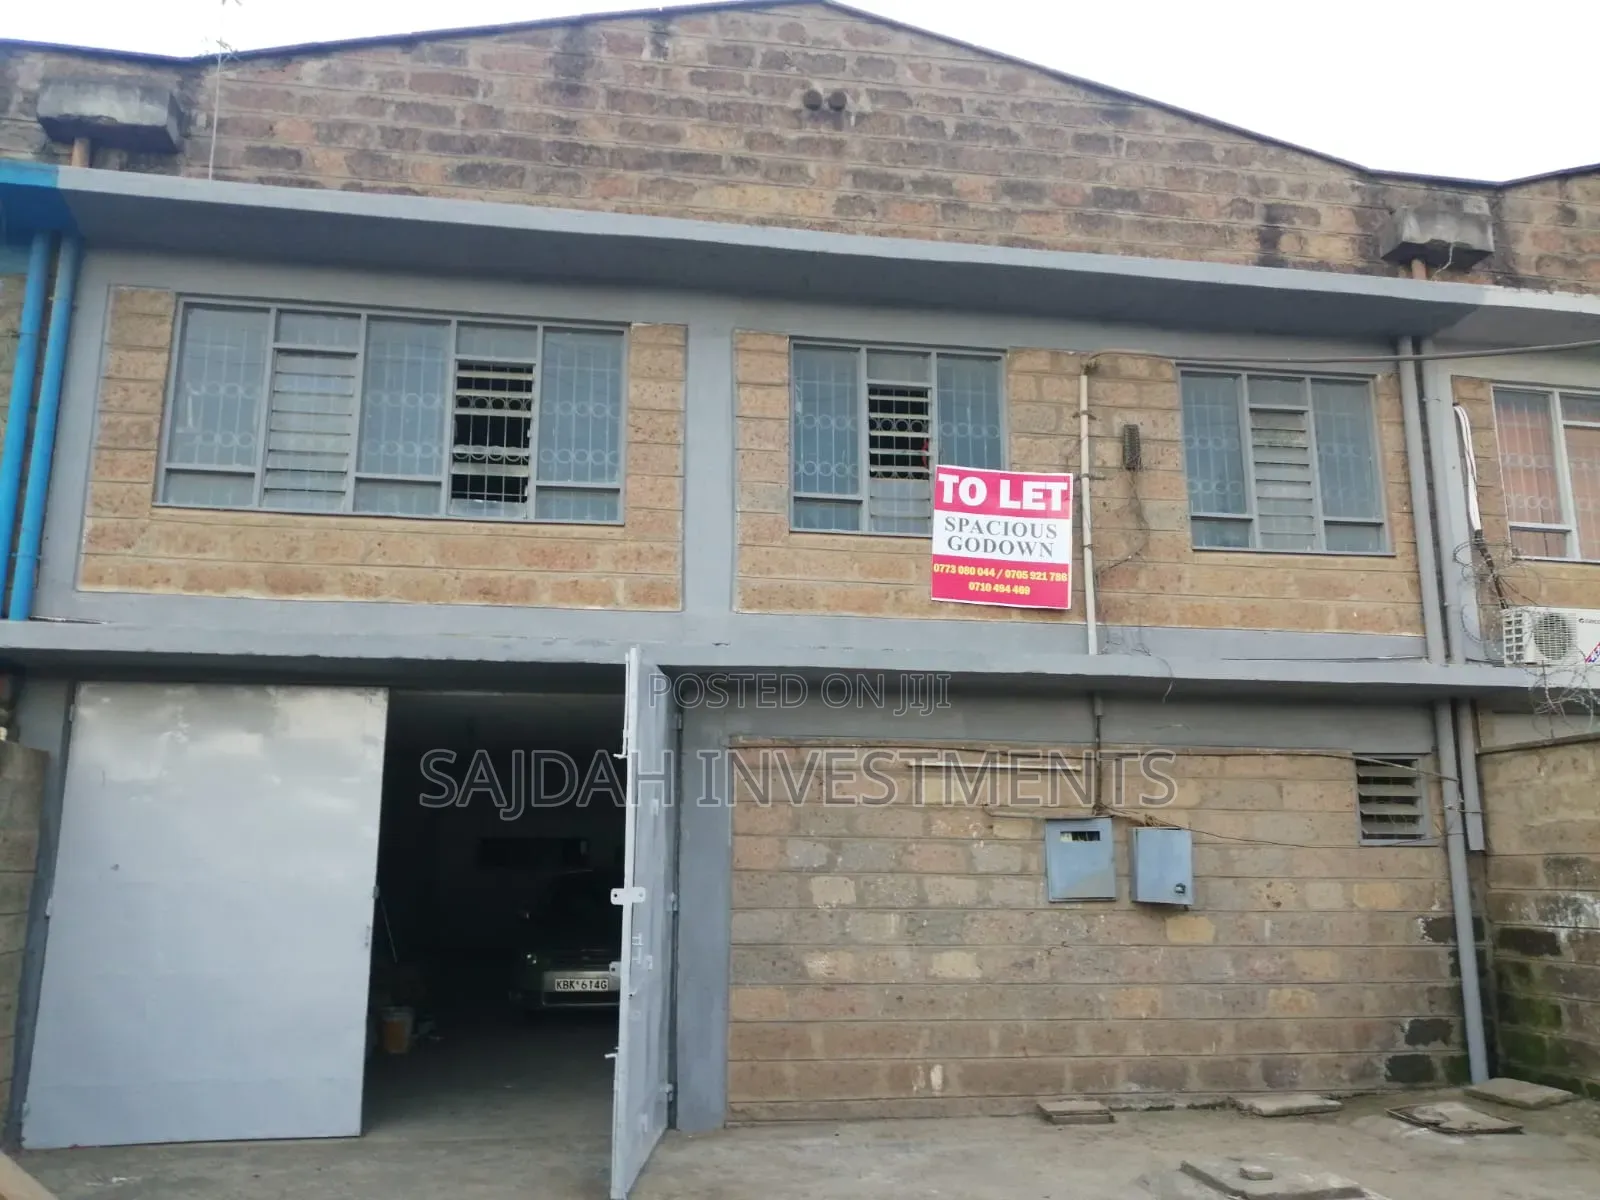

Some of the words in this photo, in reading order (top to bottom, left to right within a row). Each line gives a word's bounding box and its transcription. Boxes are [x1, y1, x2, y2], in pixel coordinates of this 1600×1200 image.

[938, 473, 987, 506] TO
[1000, 479, 1068, 511] LET
[945, 516, 1057, 539] SPACIOUS
[947, 535, 1054, 558] GODOWN
[934, 563, 956, 574] 0773
